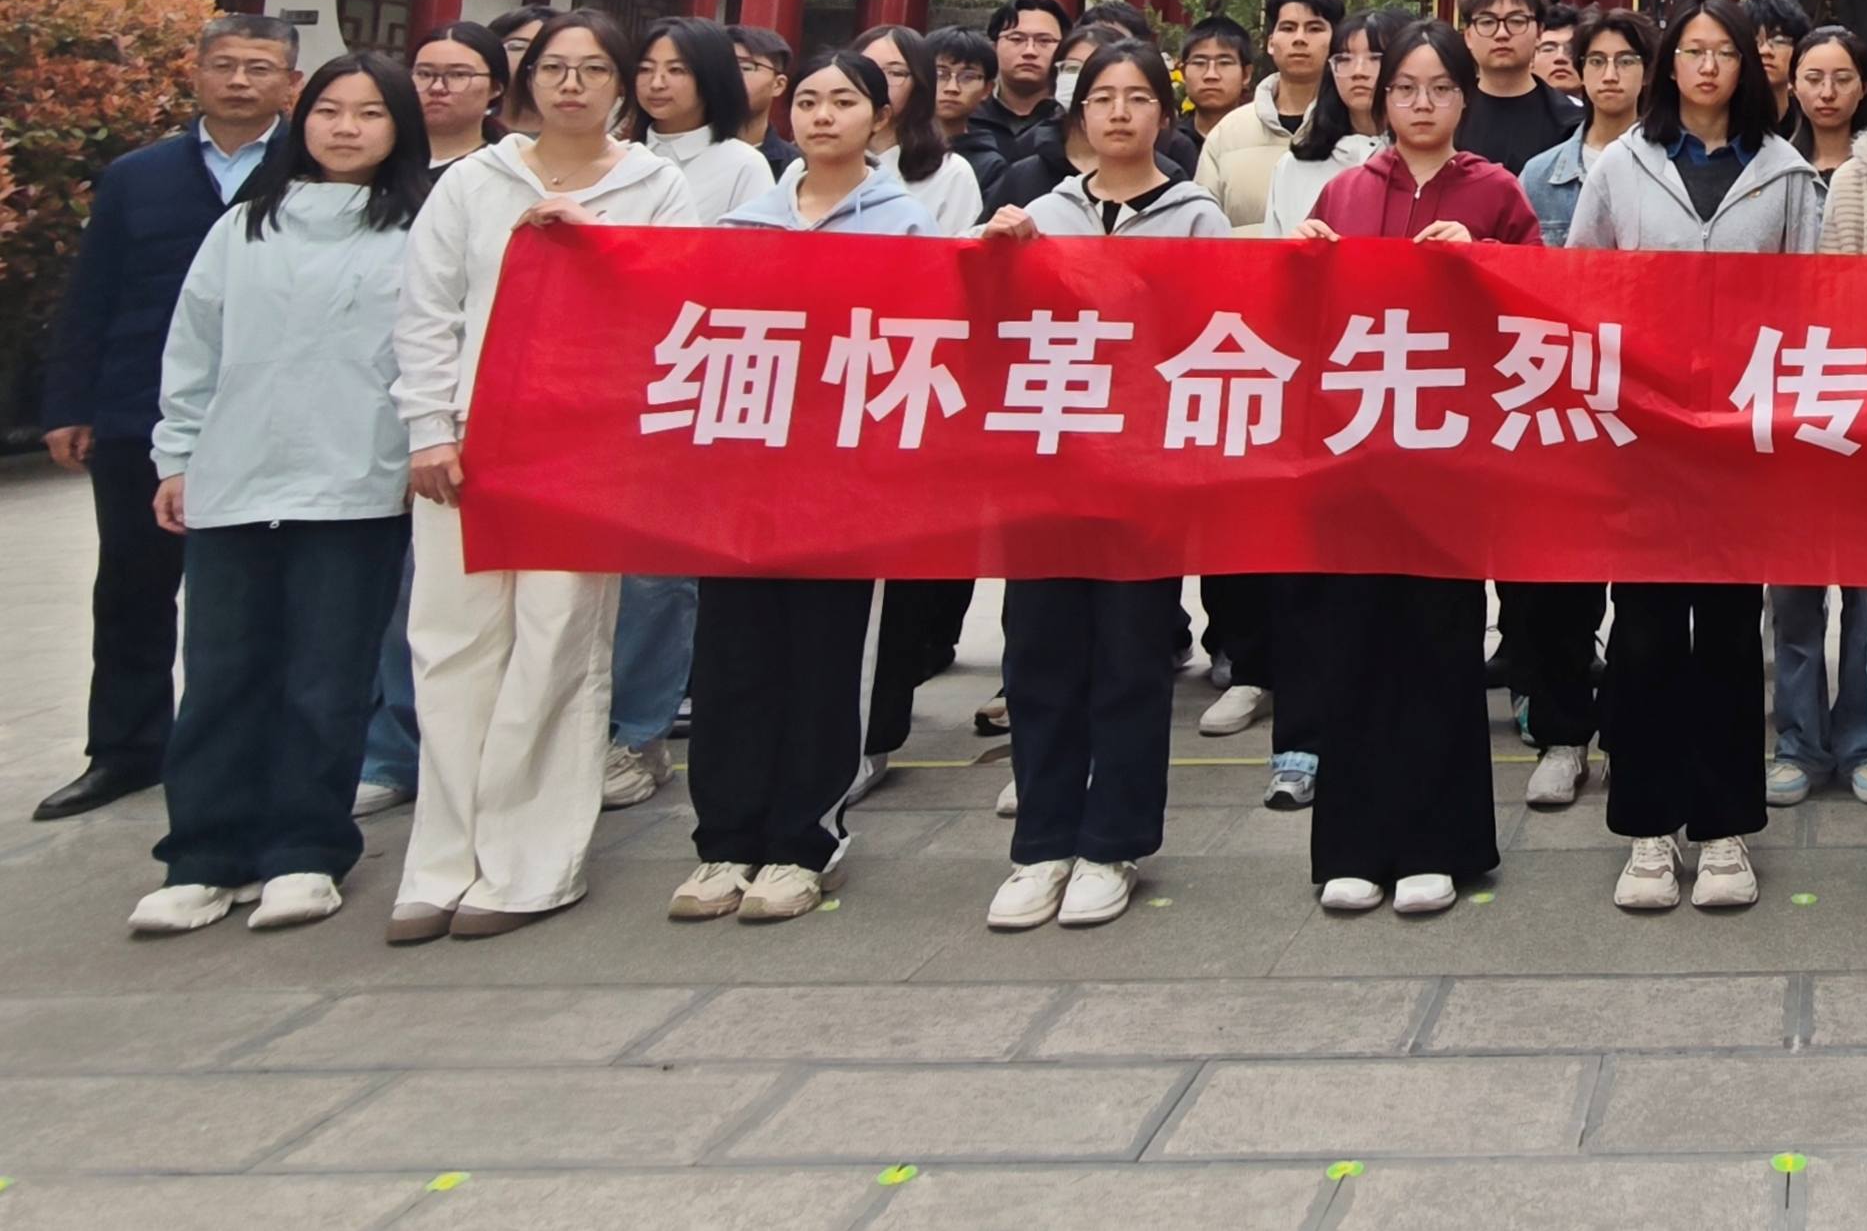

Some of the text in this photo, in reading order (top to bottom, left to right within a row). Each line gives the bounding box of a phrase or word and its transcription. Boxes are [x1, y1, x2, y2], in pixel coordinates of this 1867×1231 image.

[639, 300, 1638, 456] 缅怀革命先烈
